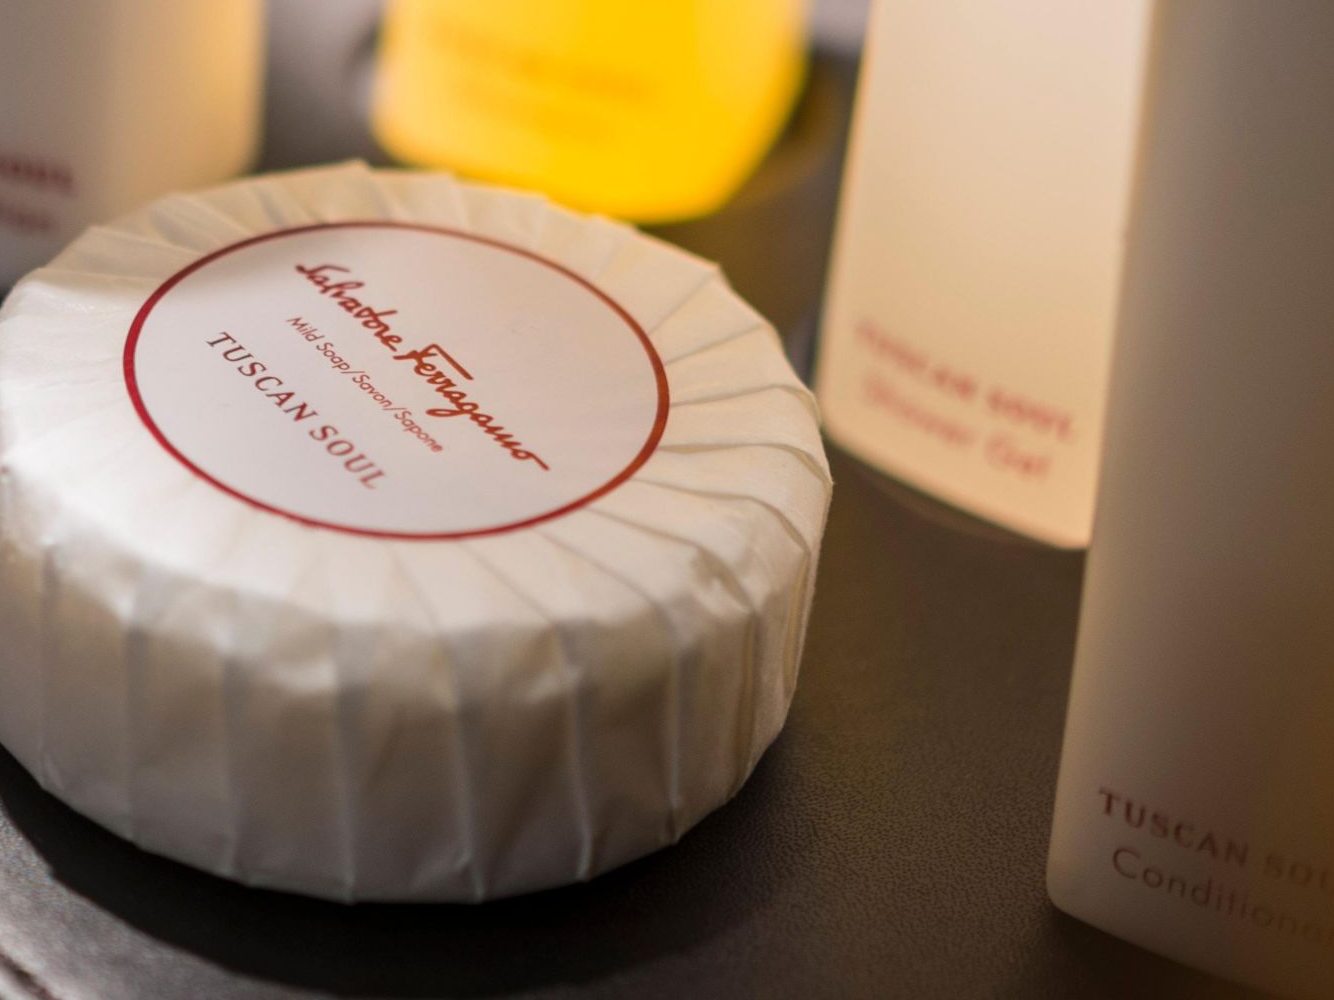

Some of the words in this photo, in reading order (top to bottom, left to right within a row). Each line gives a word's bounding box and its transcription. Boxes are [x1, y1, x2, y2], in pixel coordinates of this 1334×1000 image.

[205, 331, 319, 422] TUSCAN
[308, 424, 388, 490] SOUL
[285, 316, 325, 343] Mild
[315, 341, 444, 453] Soap/Savon/Sapone
[295, 264, 403, 352] Salvatore
[393, 343, 549, 471] Ferragamo
[1098, 787, 1250, 867] TUSCAN
